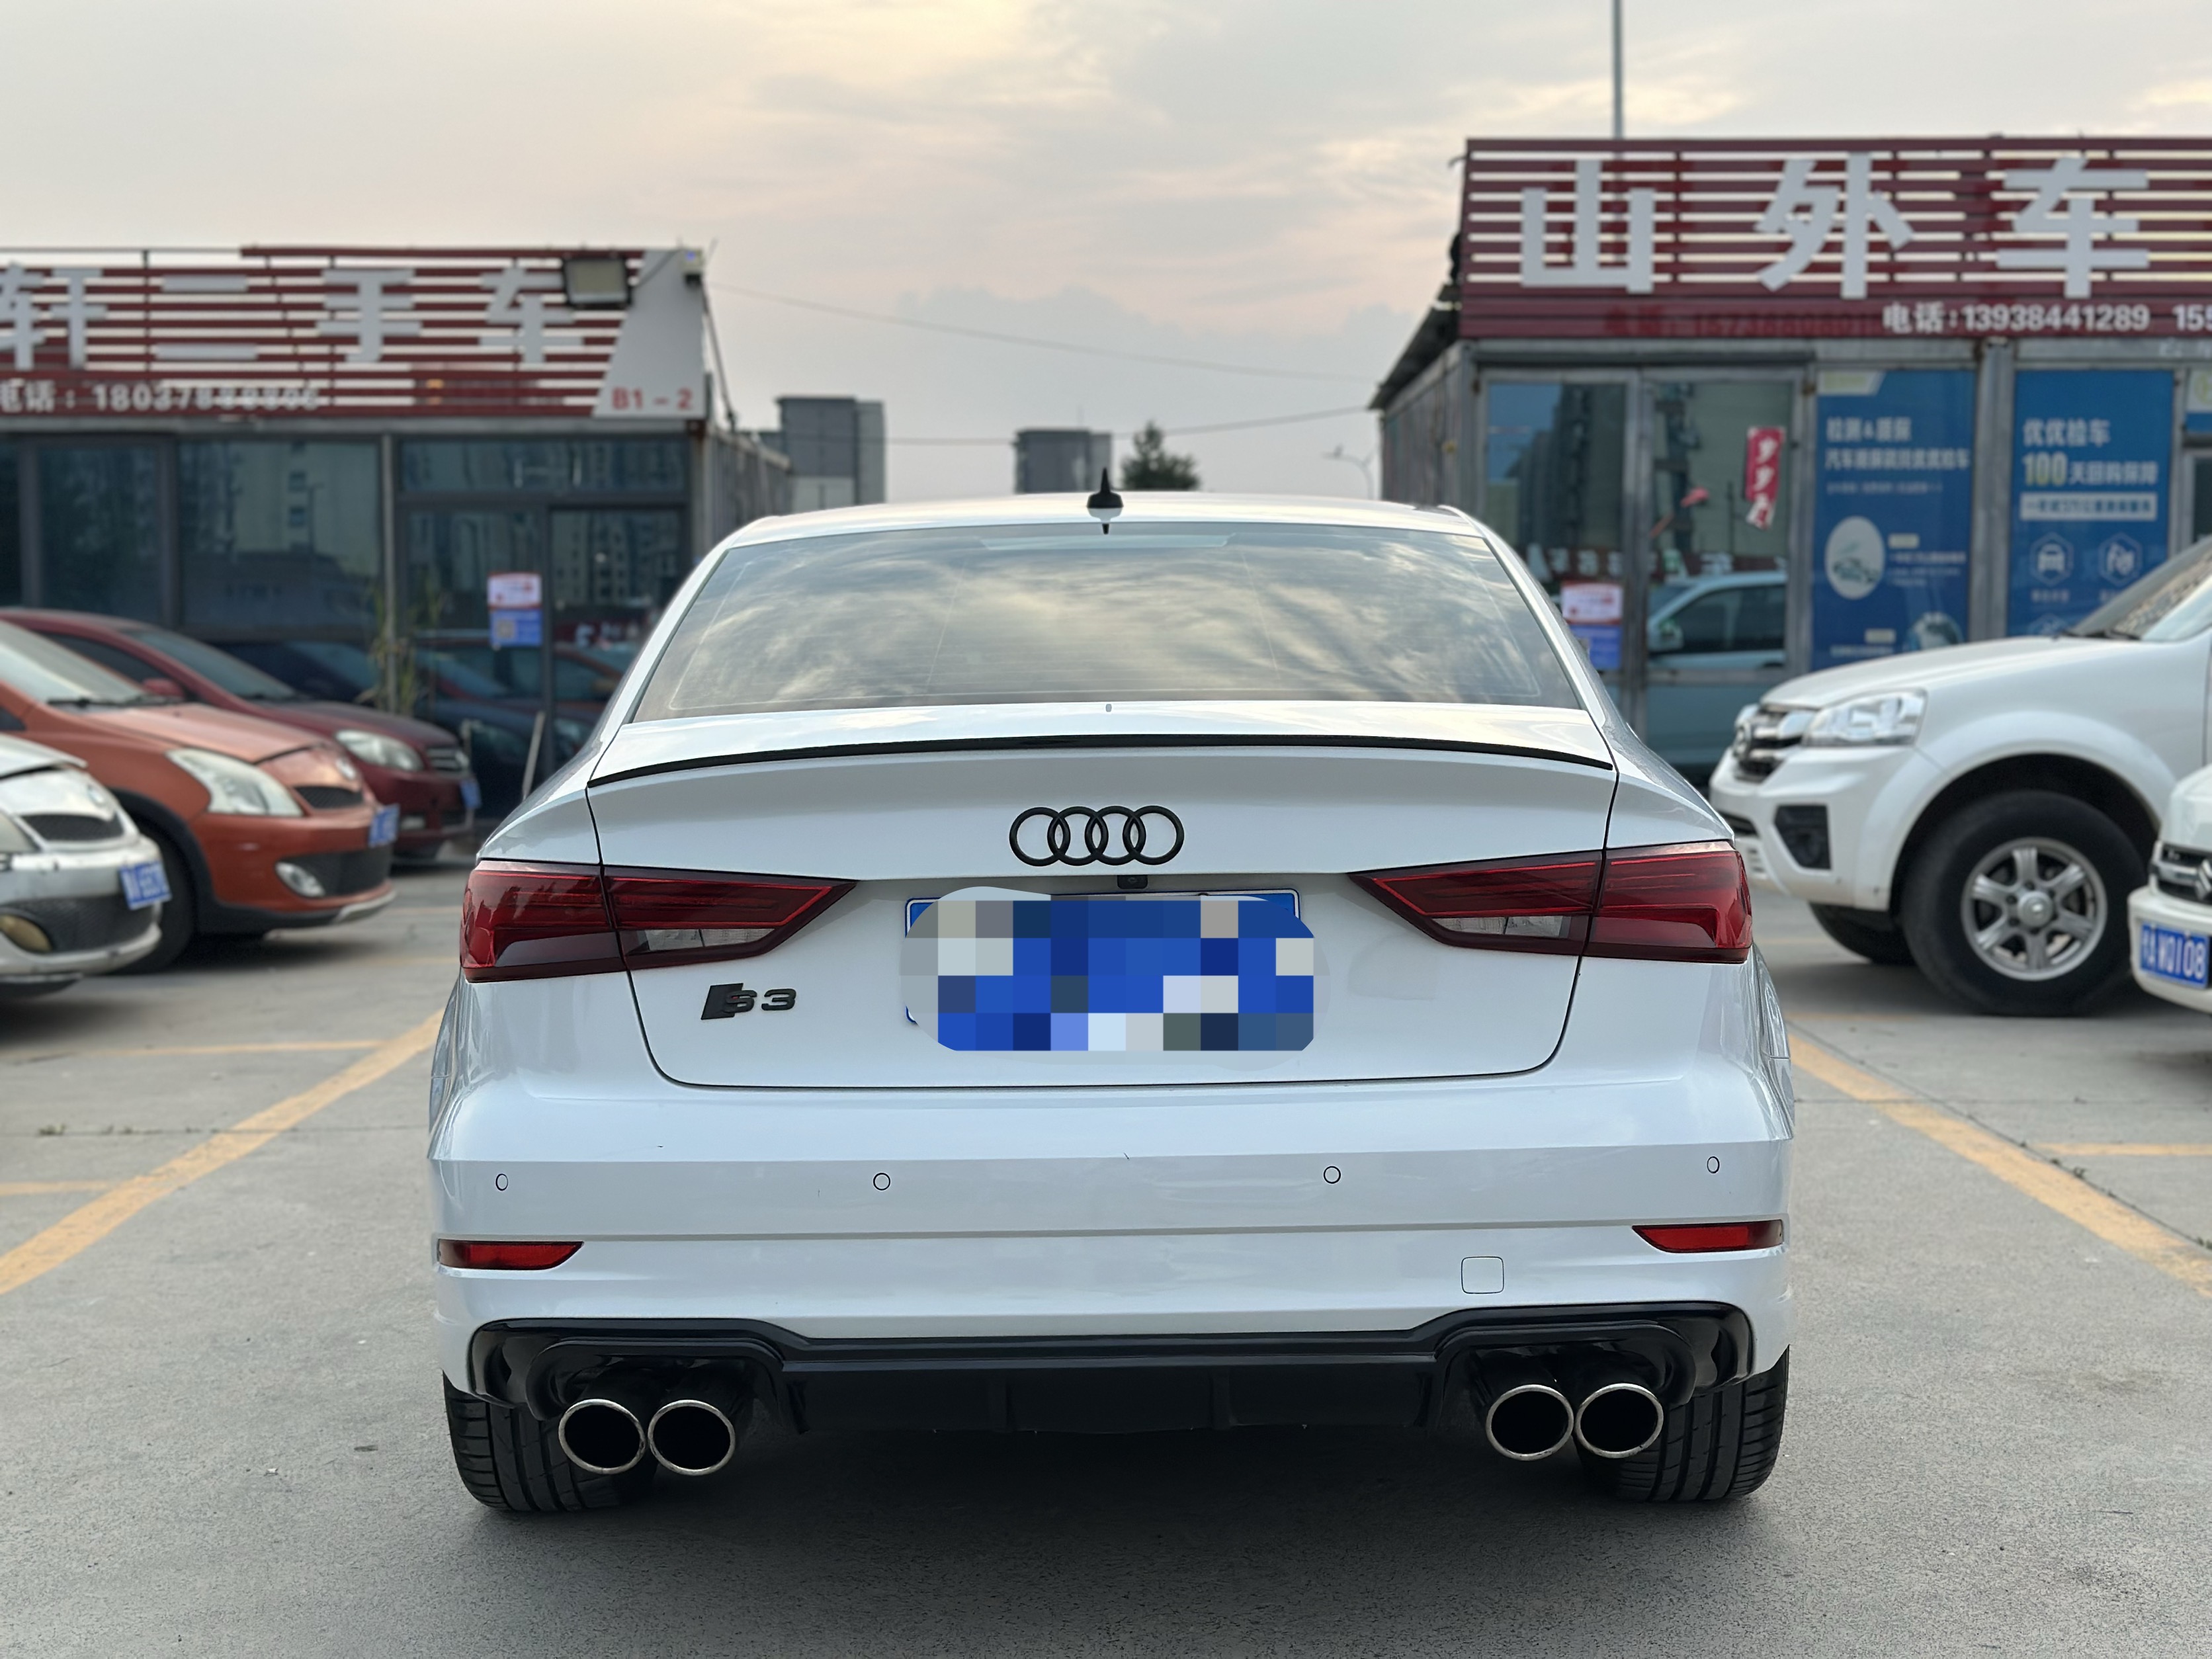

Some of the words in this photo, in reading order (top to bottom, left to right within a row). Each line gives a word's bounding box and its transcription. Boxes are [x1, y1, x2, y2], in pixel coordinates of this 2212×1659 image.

[1521, 153, 2149, 299] 山外车
[718, 986, 796, 1014] S3
